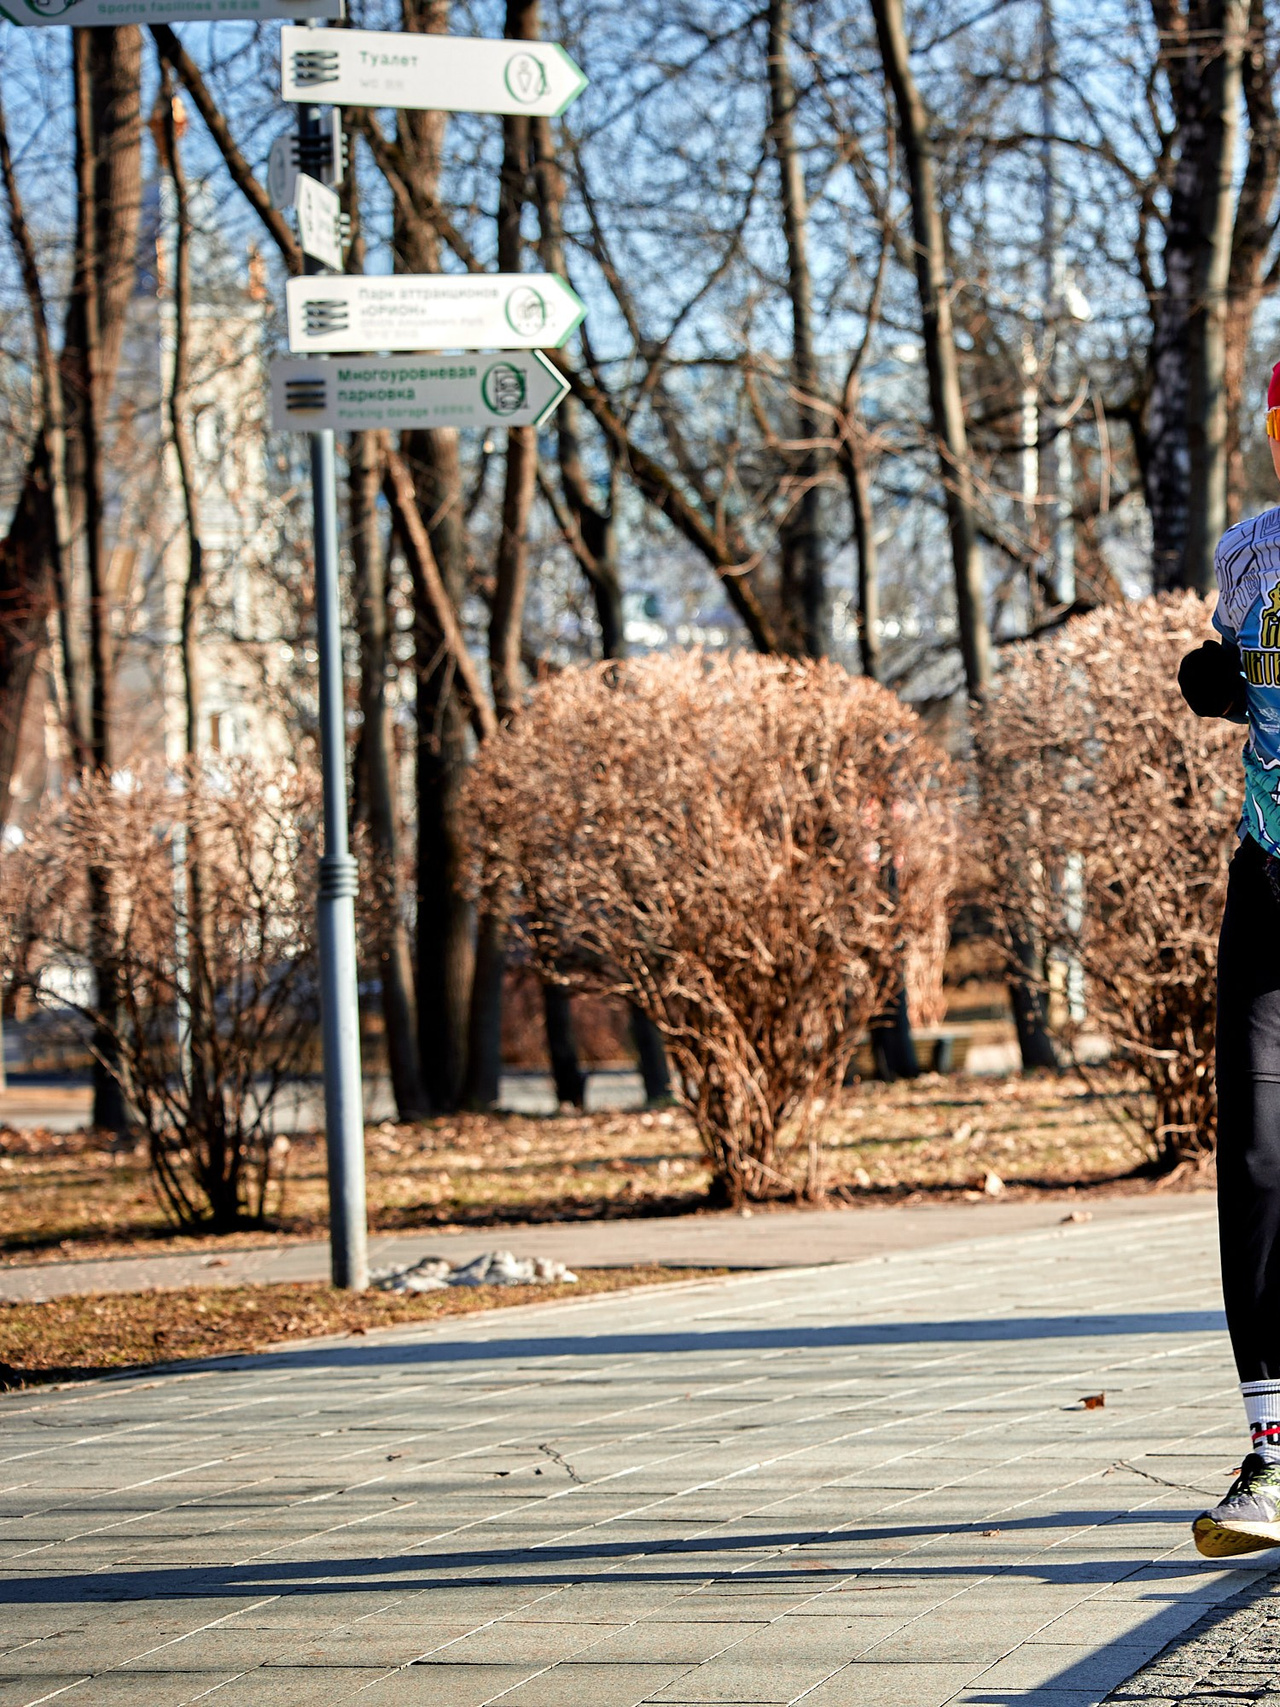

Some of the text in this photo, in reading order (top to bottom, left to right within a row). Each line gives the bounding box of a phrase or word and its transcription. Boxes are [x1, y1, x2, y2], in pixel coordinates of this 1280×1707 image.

[358, 50, 419, 67] Туалет
[357, 287, 396, 300] Парк
[337, 365, 478, 384] Многоуровневая
[337, 387, 416, 402] парковка
